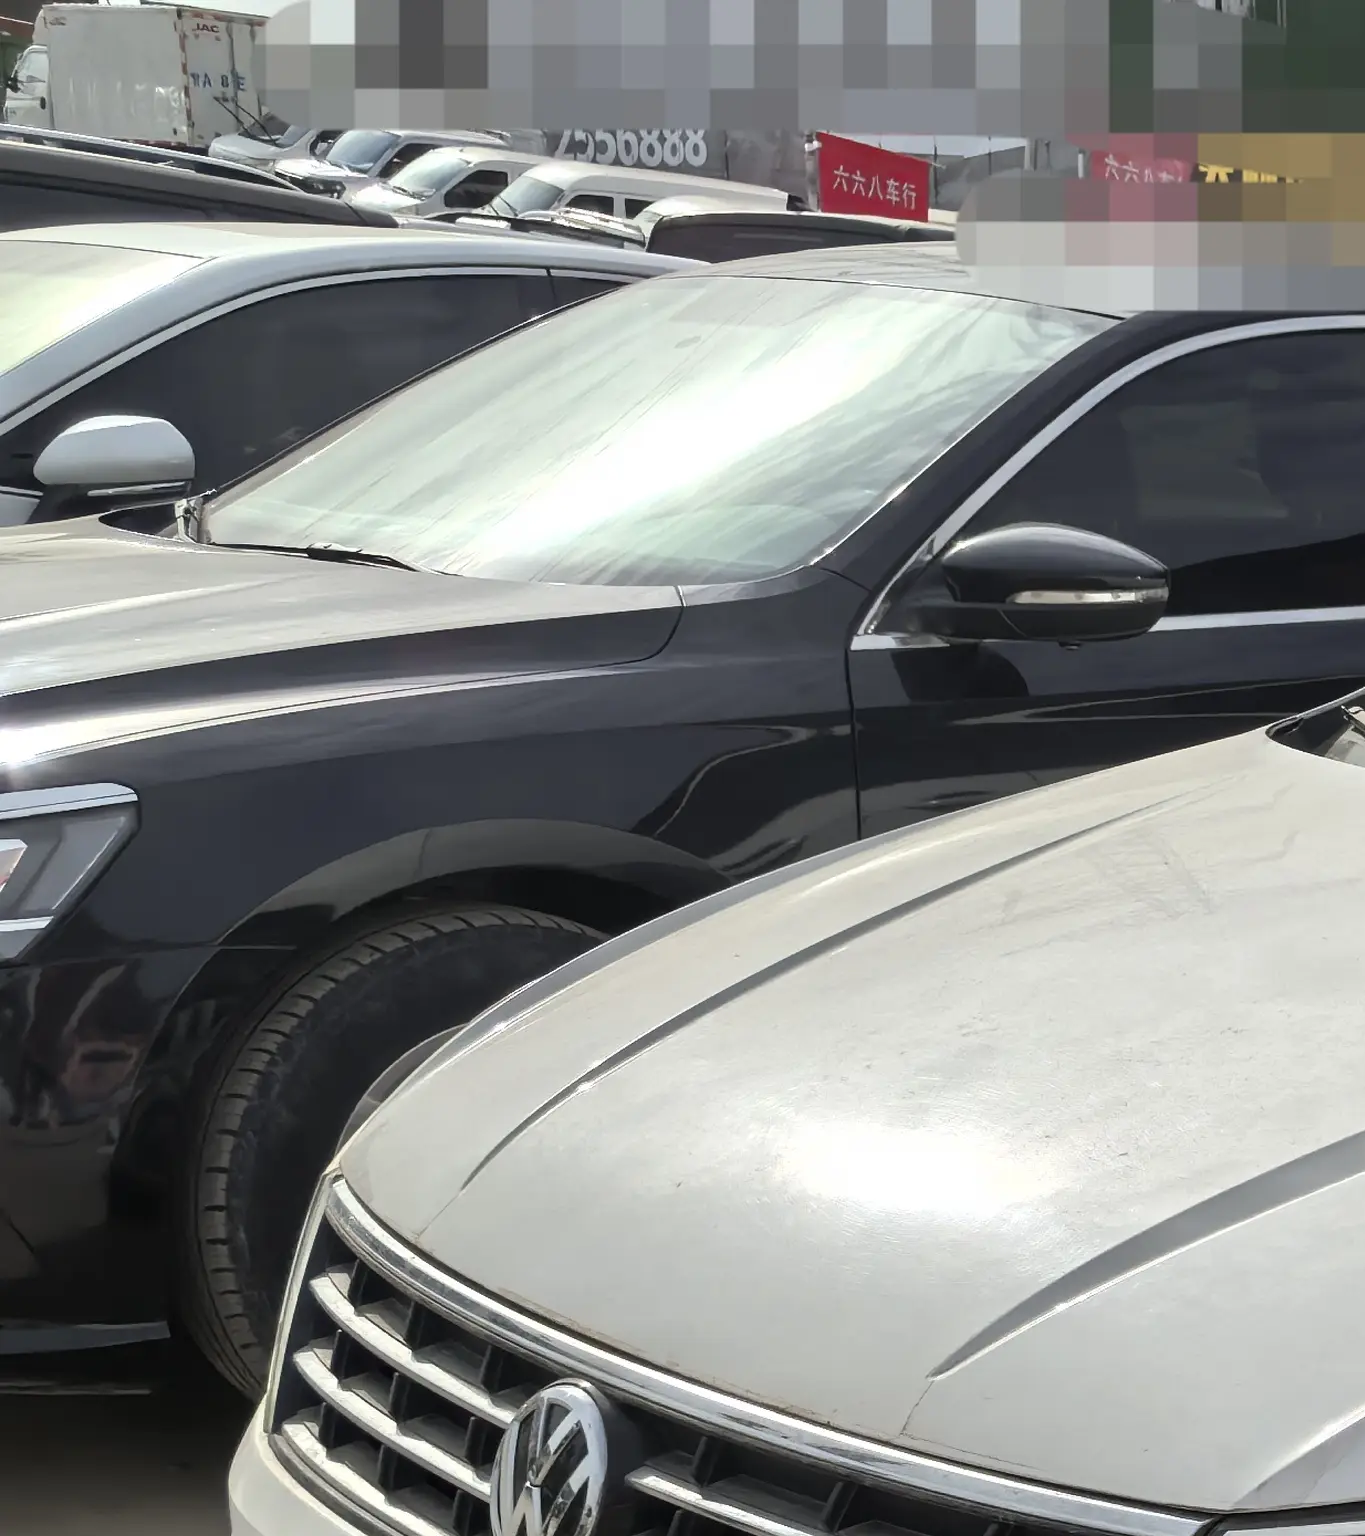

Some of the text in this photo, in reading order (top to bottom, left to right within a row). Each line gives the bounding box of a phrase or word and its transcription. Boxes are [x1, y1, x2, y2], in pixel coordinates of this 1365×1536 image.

[192, 22, 220, 33] JAC
[832, 164, 917, 210] 六六八车行
